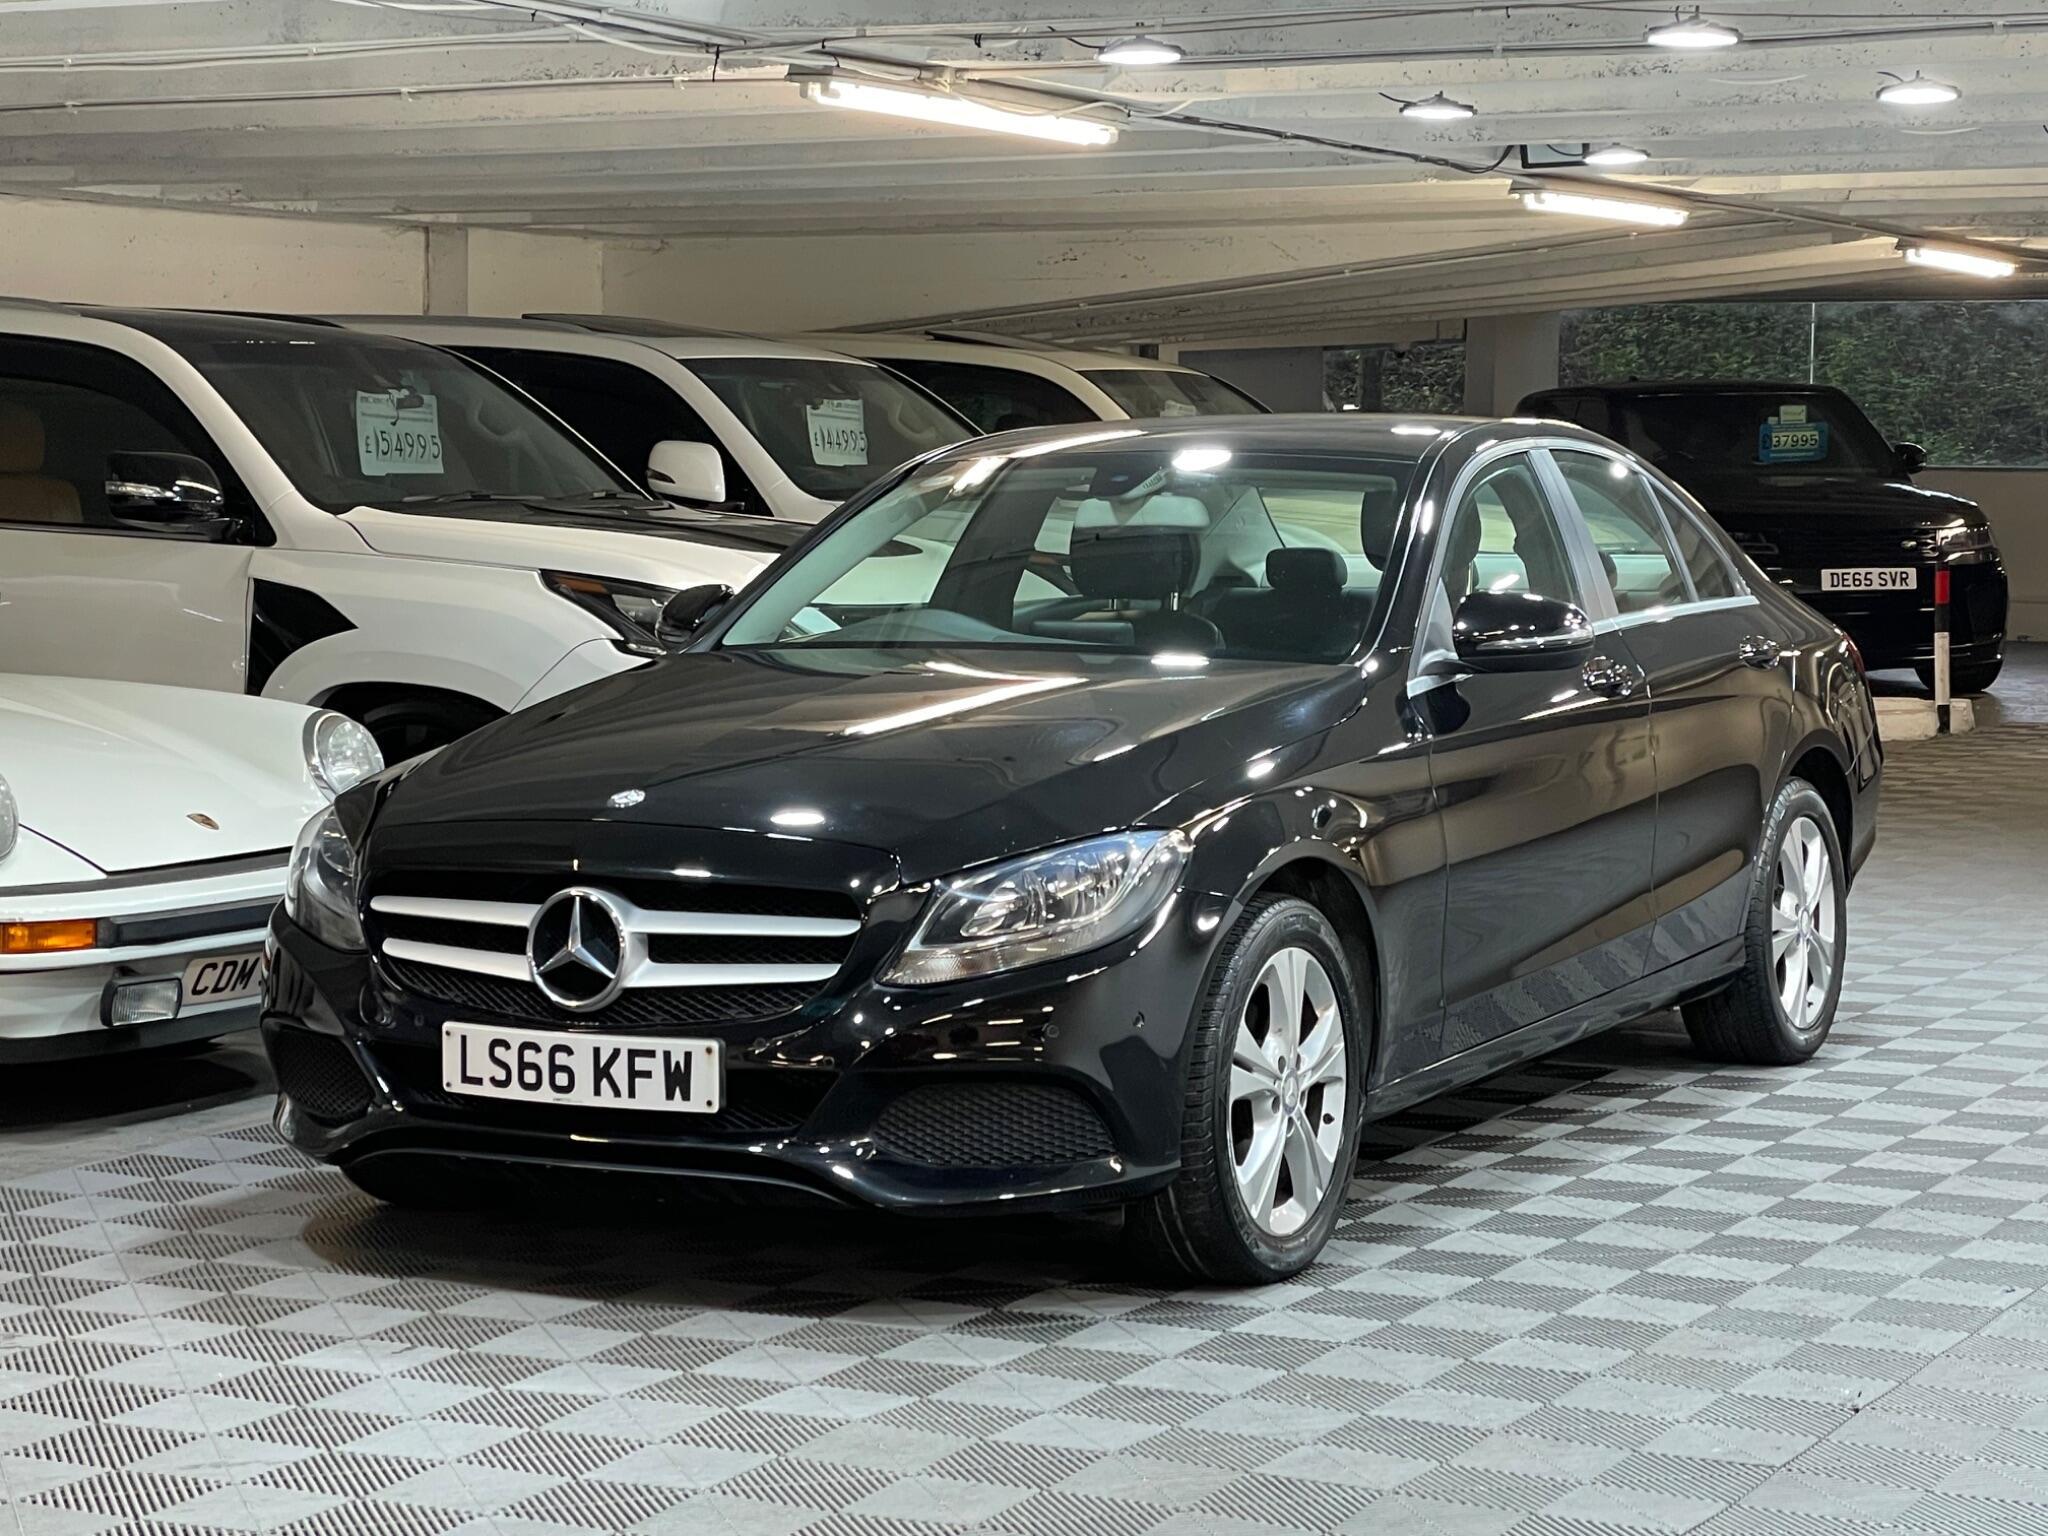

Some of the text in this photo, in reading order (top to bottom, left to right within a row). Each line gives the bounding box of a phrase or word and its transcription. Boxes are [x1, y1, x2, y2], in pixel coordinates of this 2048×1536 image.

[1830, 571, 1909, 588] DE65 SVR
[191, 957, 260, 996] CDM
[460, 1034, 692, 1102] LS66 KFW
